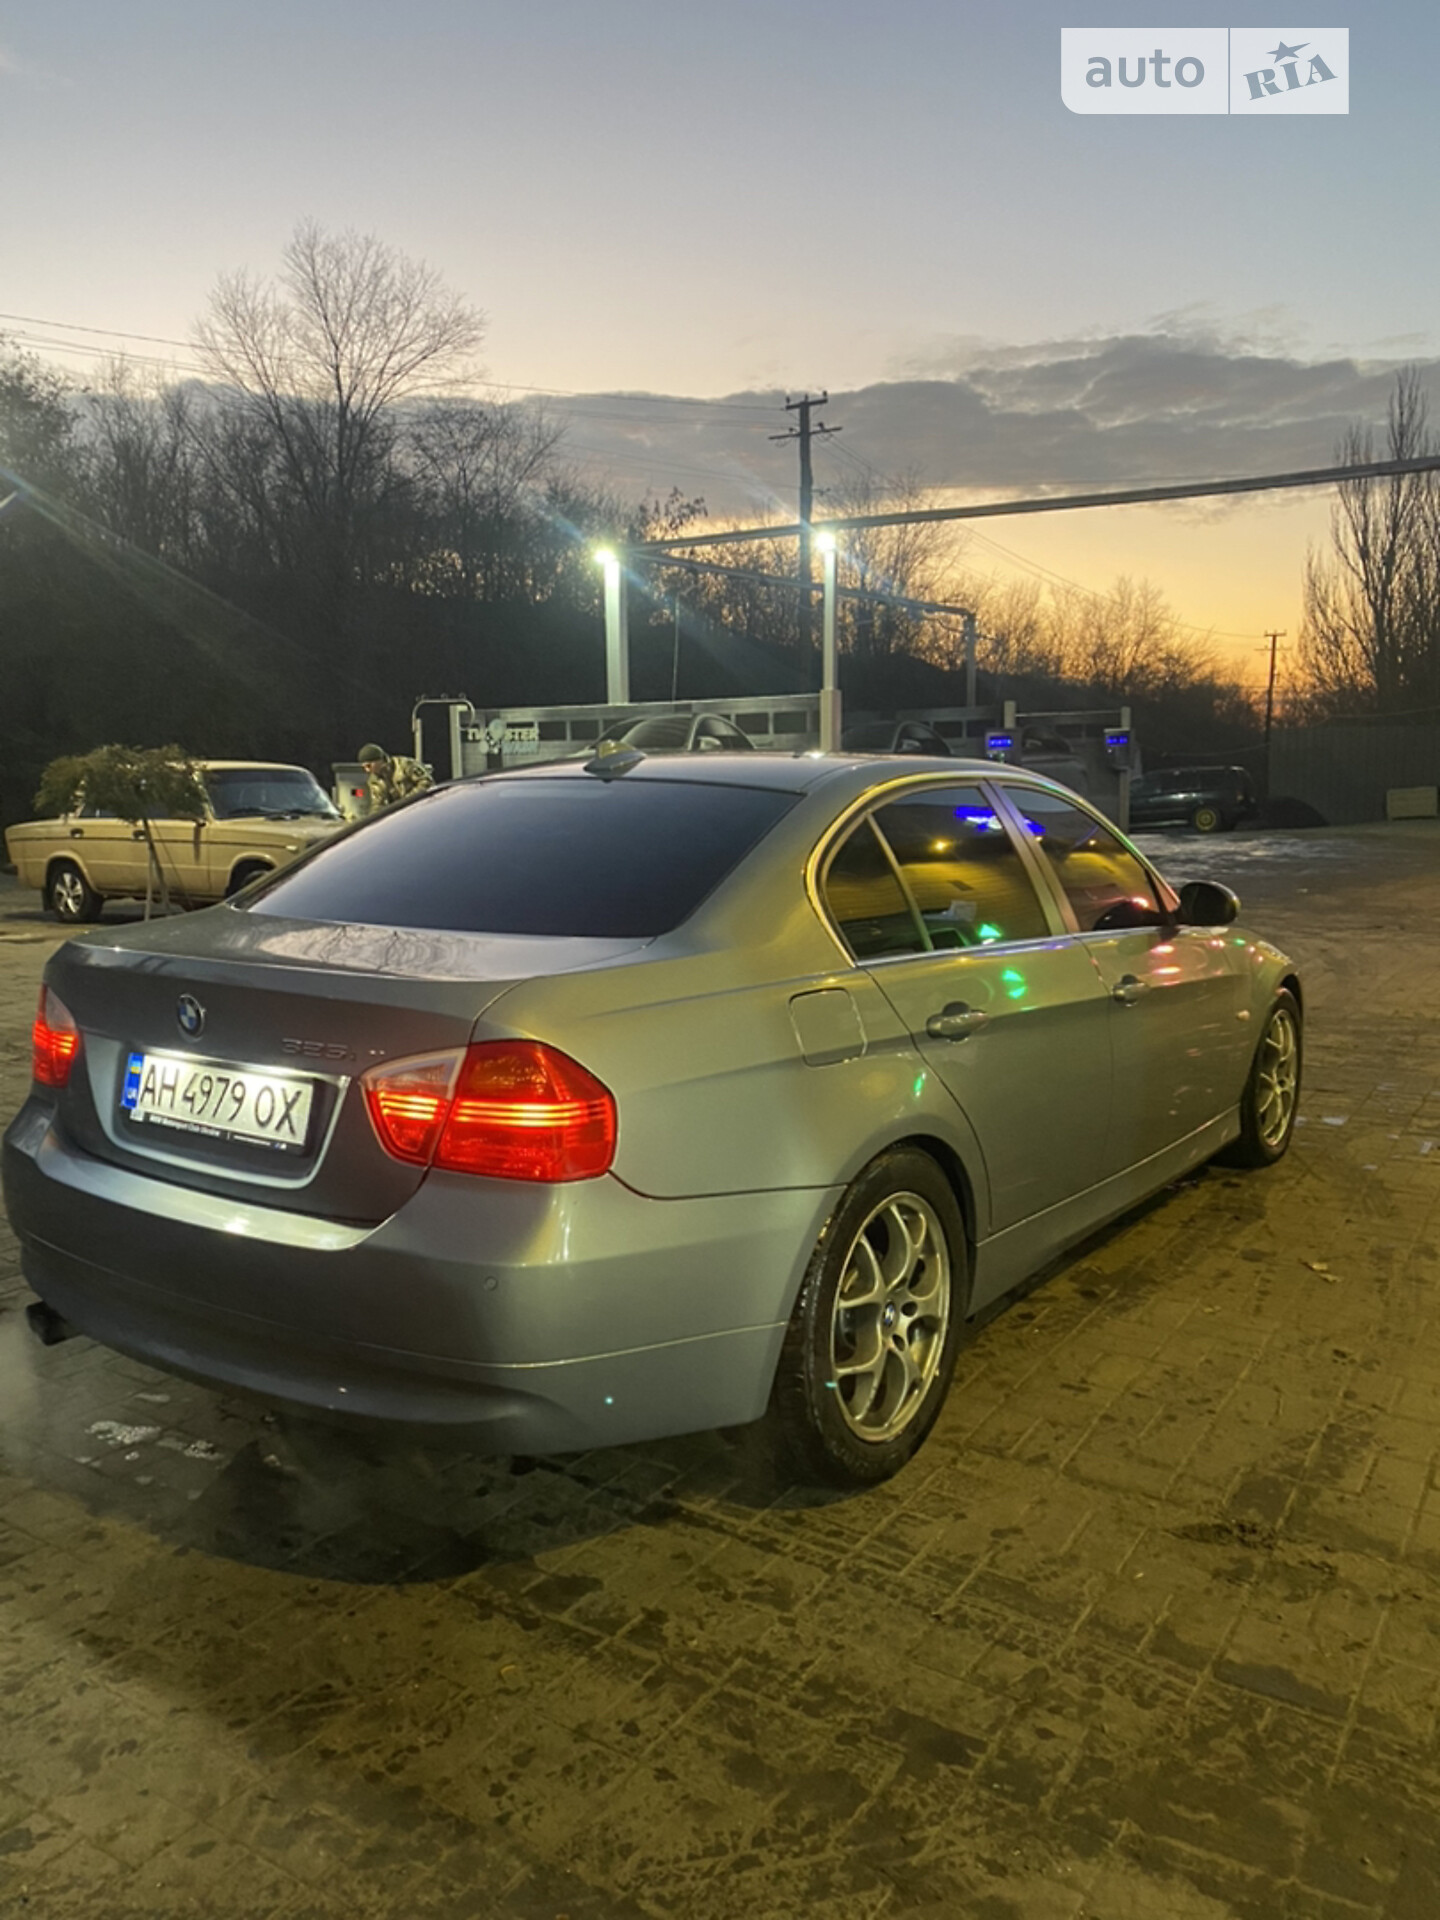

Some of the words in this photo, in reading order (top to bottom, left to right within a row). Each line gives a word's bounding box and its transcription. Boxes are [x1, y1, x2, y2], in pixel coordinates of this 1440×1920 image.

[140, 1064, 180, 1109] AH
[182, 1071, 248, 1122] 4979
[254, 1085, 303, 1136] OX
